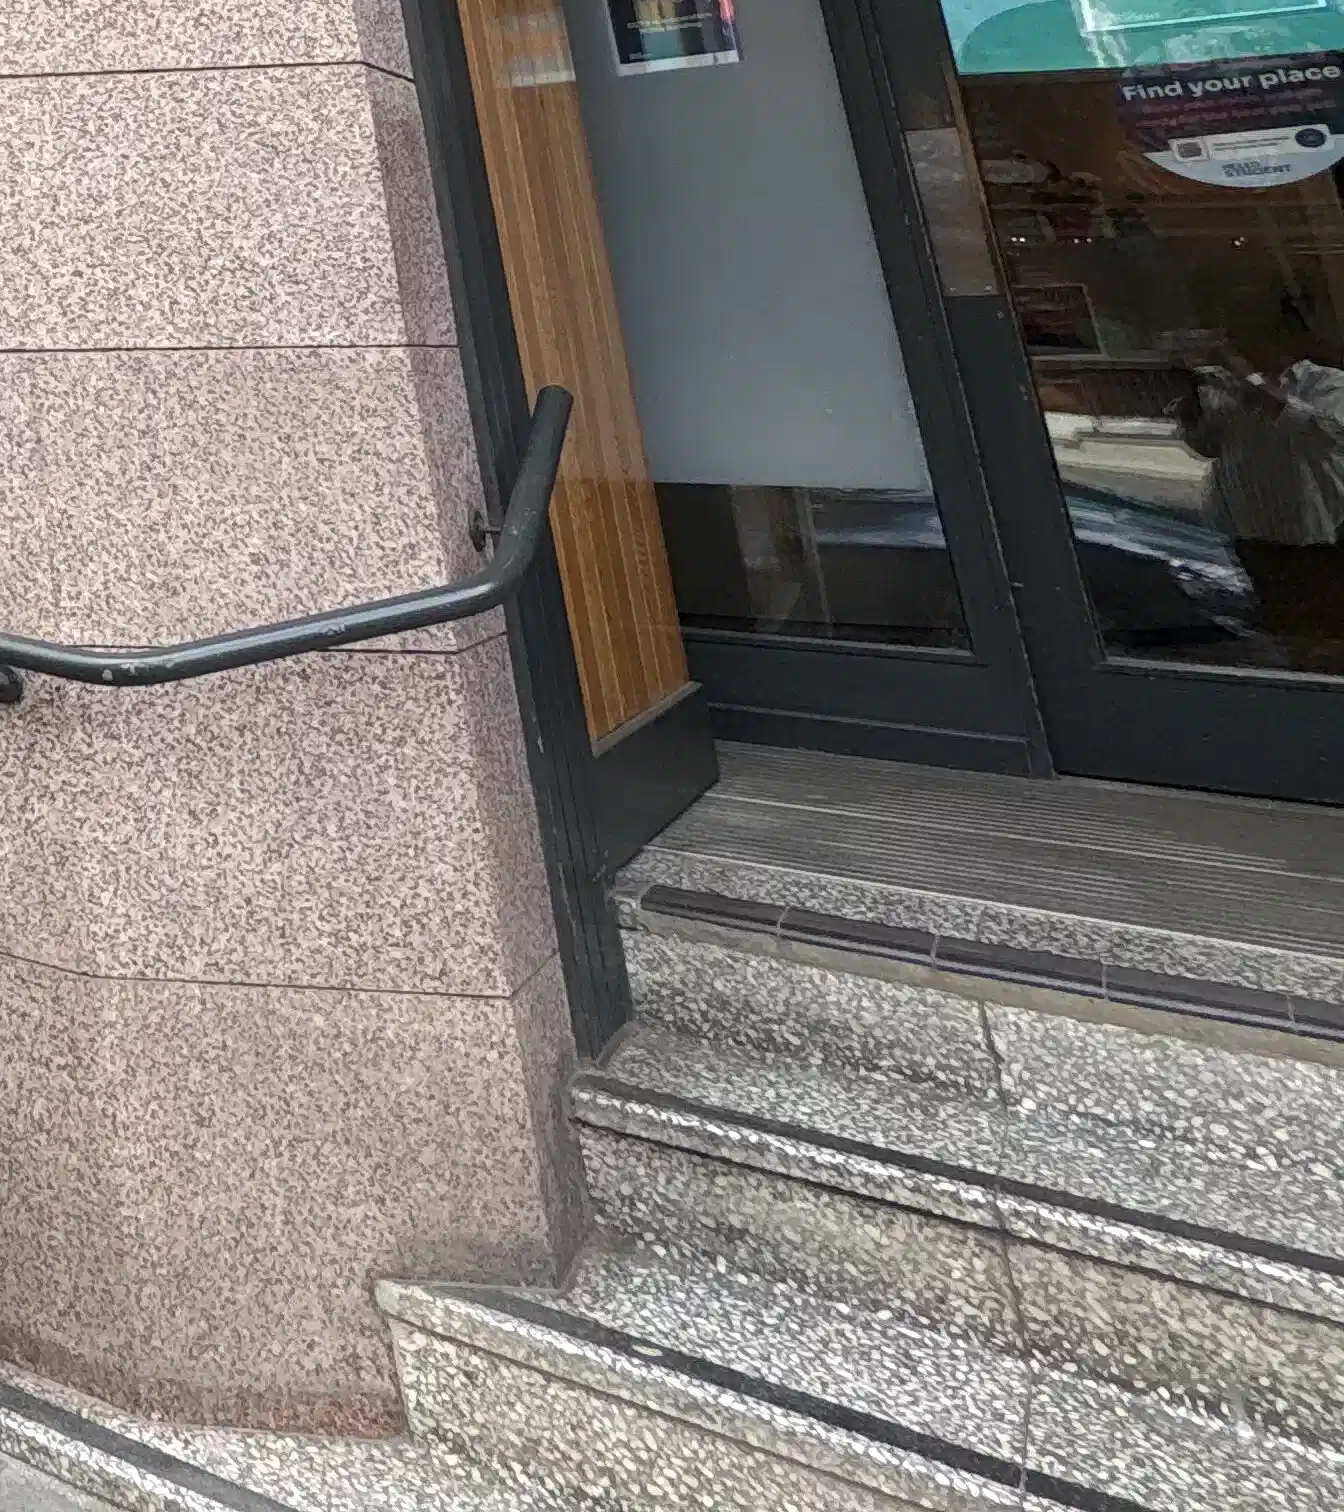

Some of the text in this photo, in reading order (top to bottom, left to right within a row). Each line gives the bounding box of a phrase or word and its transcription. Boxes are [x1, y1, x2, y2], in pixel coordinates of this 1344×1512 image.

[1122, 81, 1183, 101] Find
[1187, 74, 1254, 98] your
[1258, 65, 1341, 90] place
